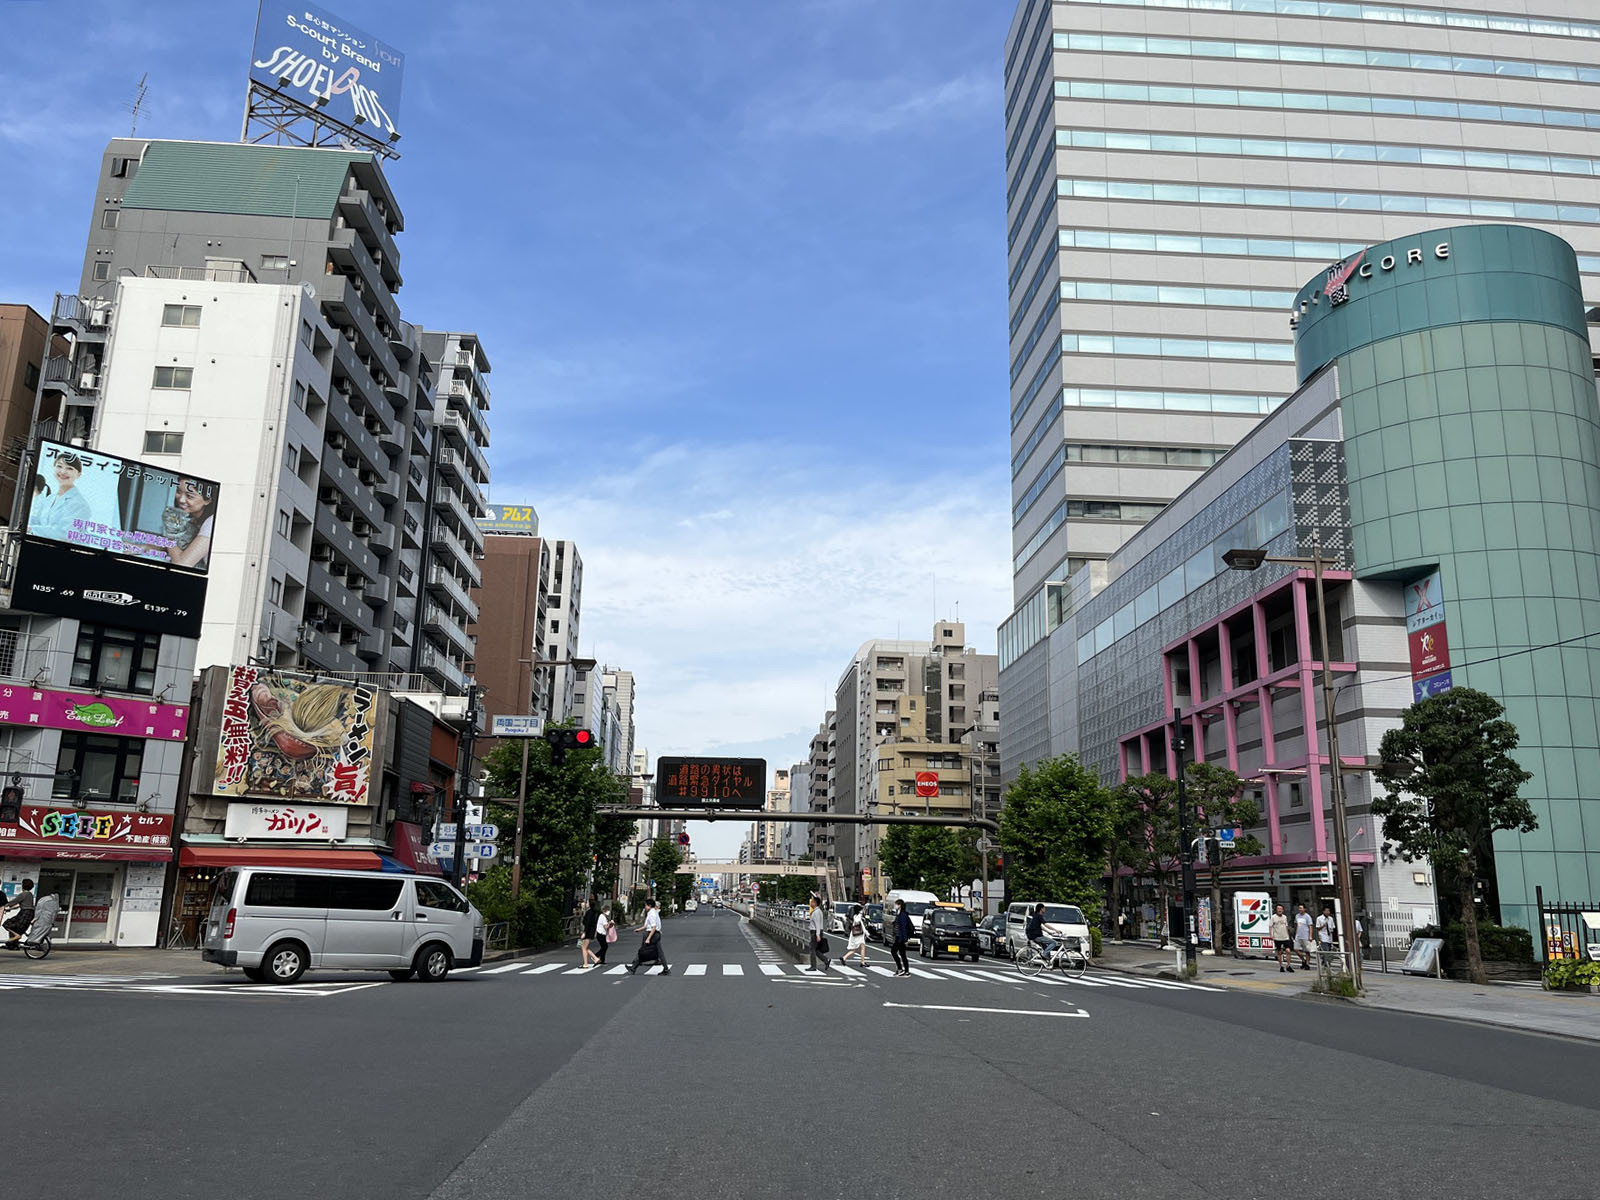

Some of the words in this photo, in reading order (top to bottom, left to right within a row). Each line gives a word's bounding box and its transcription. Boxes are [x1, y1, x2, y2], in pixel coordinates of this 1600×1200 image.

[304, 12, 366, 49] 都心型マンション
[286, 14, 338, 49] S-court
[341, 43, 381, 73] Brand
[322, 46, 340, 63] by
[1359, 242, 1450, 278] CORE
[502, 506, 533, 522] アムス
[64, 709, 92, 722] East
[93, 713, 125, 727] Leaf
[223, 665, 259, 784] 替え玉無料!!
[347, 687, 372, 764] ラーメン
[496, 718, 539, 728] 両国二丁目
[679, 763, 742, 776] 道路の異状は
[667, 774, 753, 787] 道路緊急ダイヤル
[40, 811, 114, 839] SELF
[138, 815, 164, 825] セルフ
[264, 808, 322, 835] ガツン
[125, 834, 150, 844] 不動産
